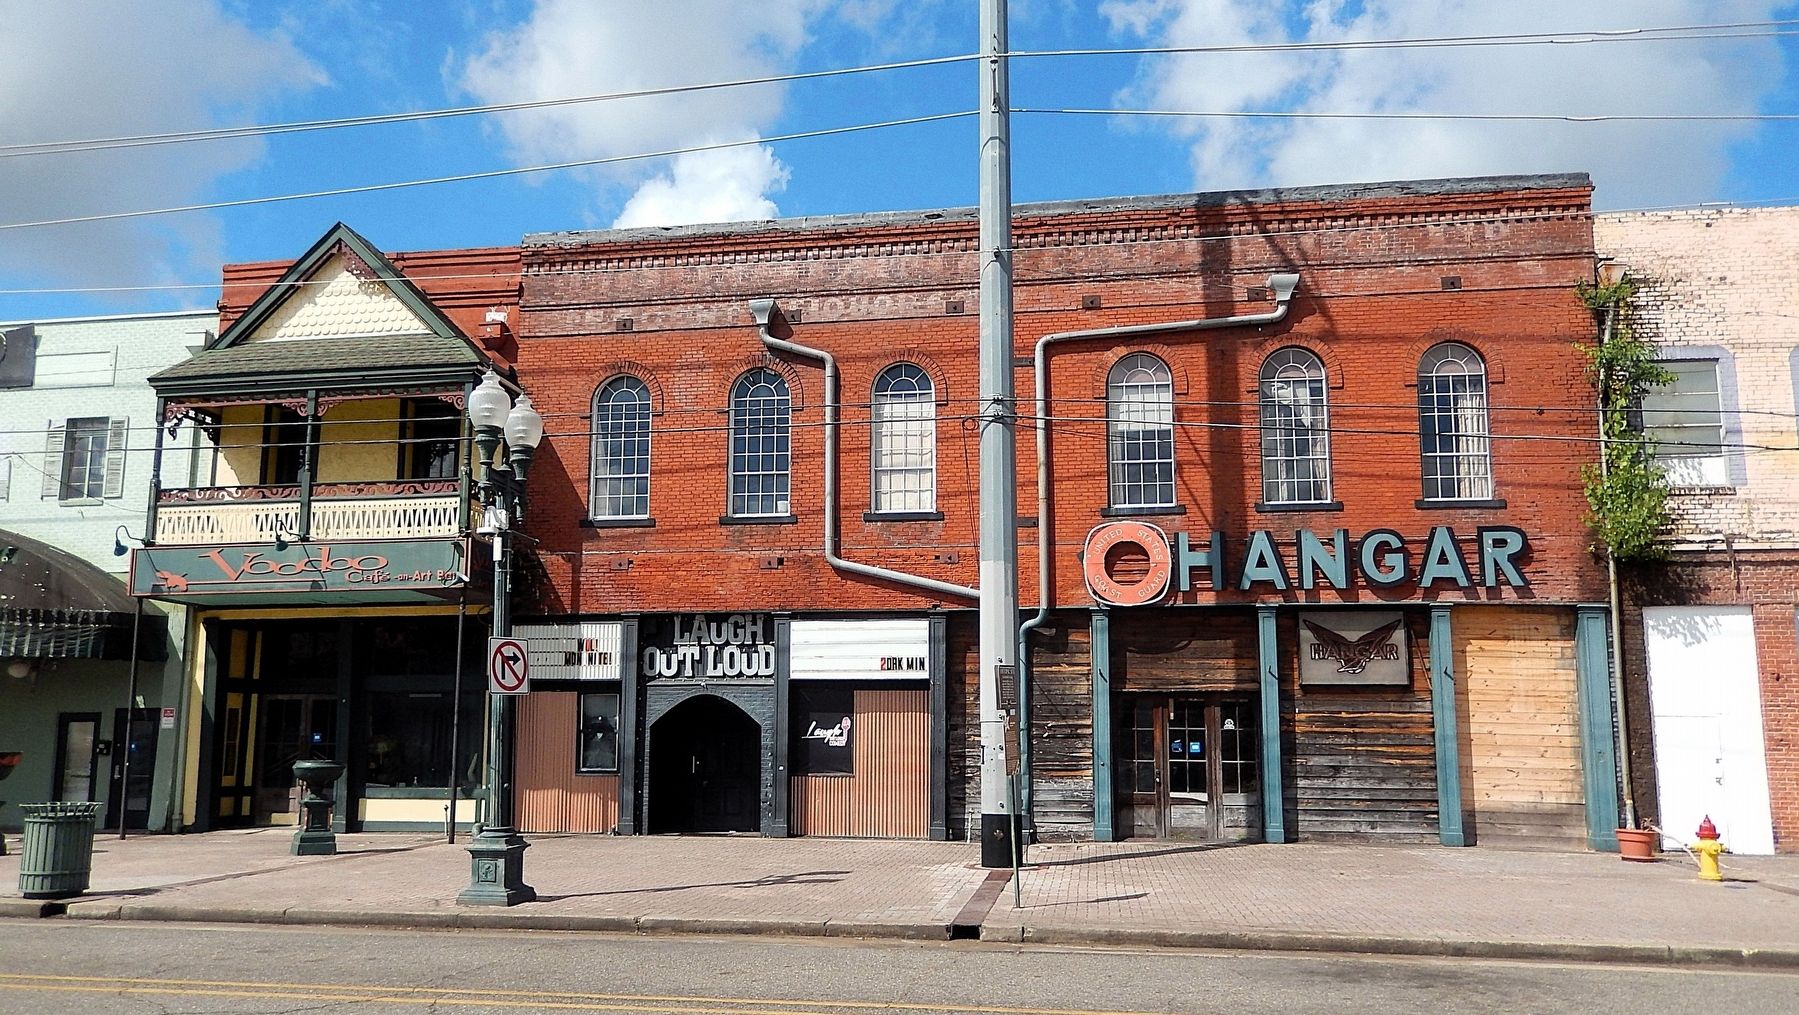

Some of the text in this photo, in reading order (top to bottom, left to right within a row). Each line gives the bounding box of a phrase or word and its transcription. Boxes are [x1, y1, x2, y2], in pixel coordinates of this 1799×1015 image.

[1094, 528, 1163, 560] UNITED STATES
[1175, 526, 1527, 592] HANGAR
[198, 546, 389, 581] Voodoo
[1138, 570, 1165, 597] GUARD
[673, 614, 765, 645] LAUGH
[643, 645, 775, 677] OUT LOUD
[906, 656, 926, 671] MIN
[1310, 643, 1399, 661] HANGAR
